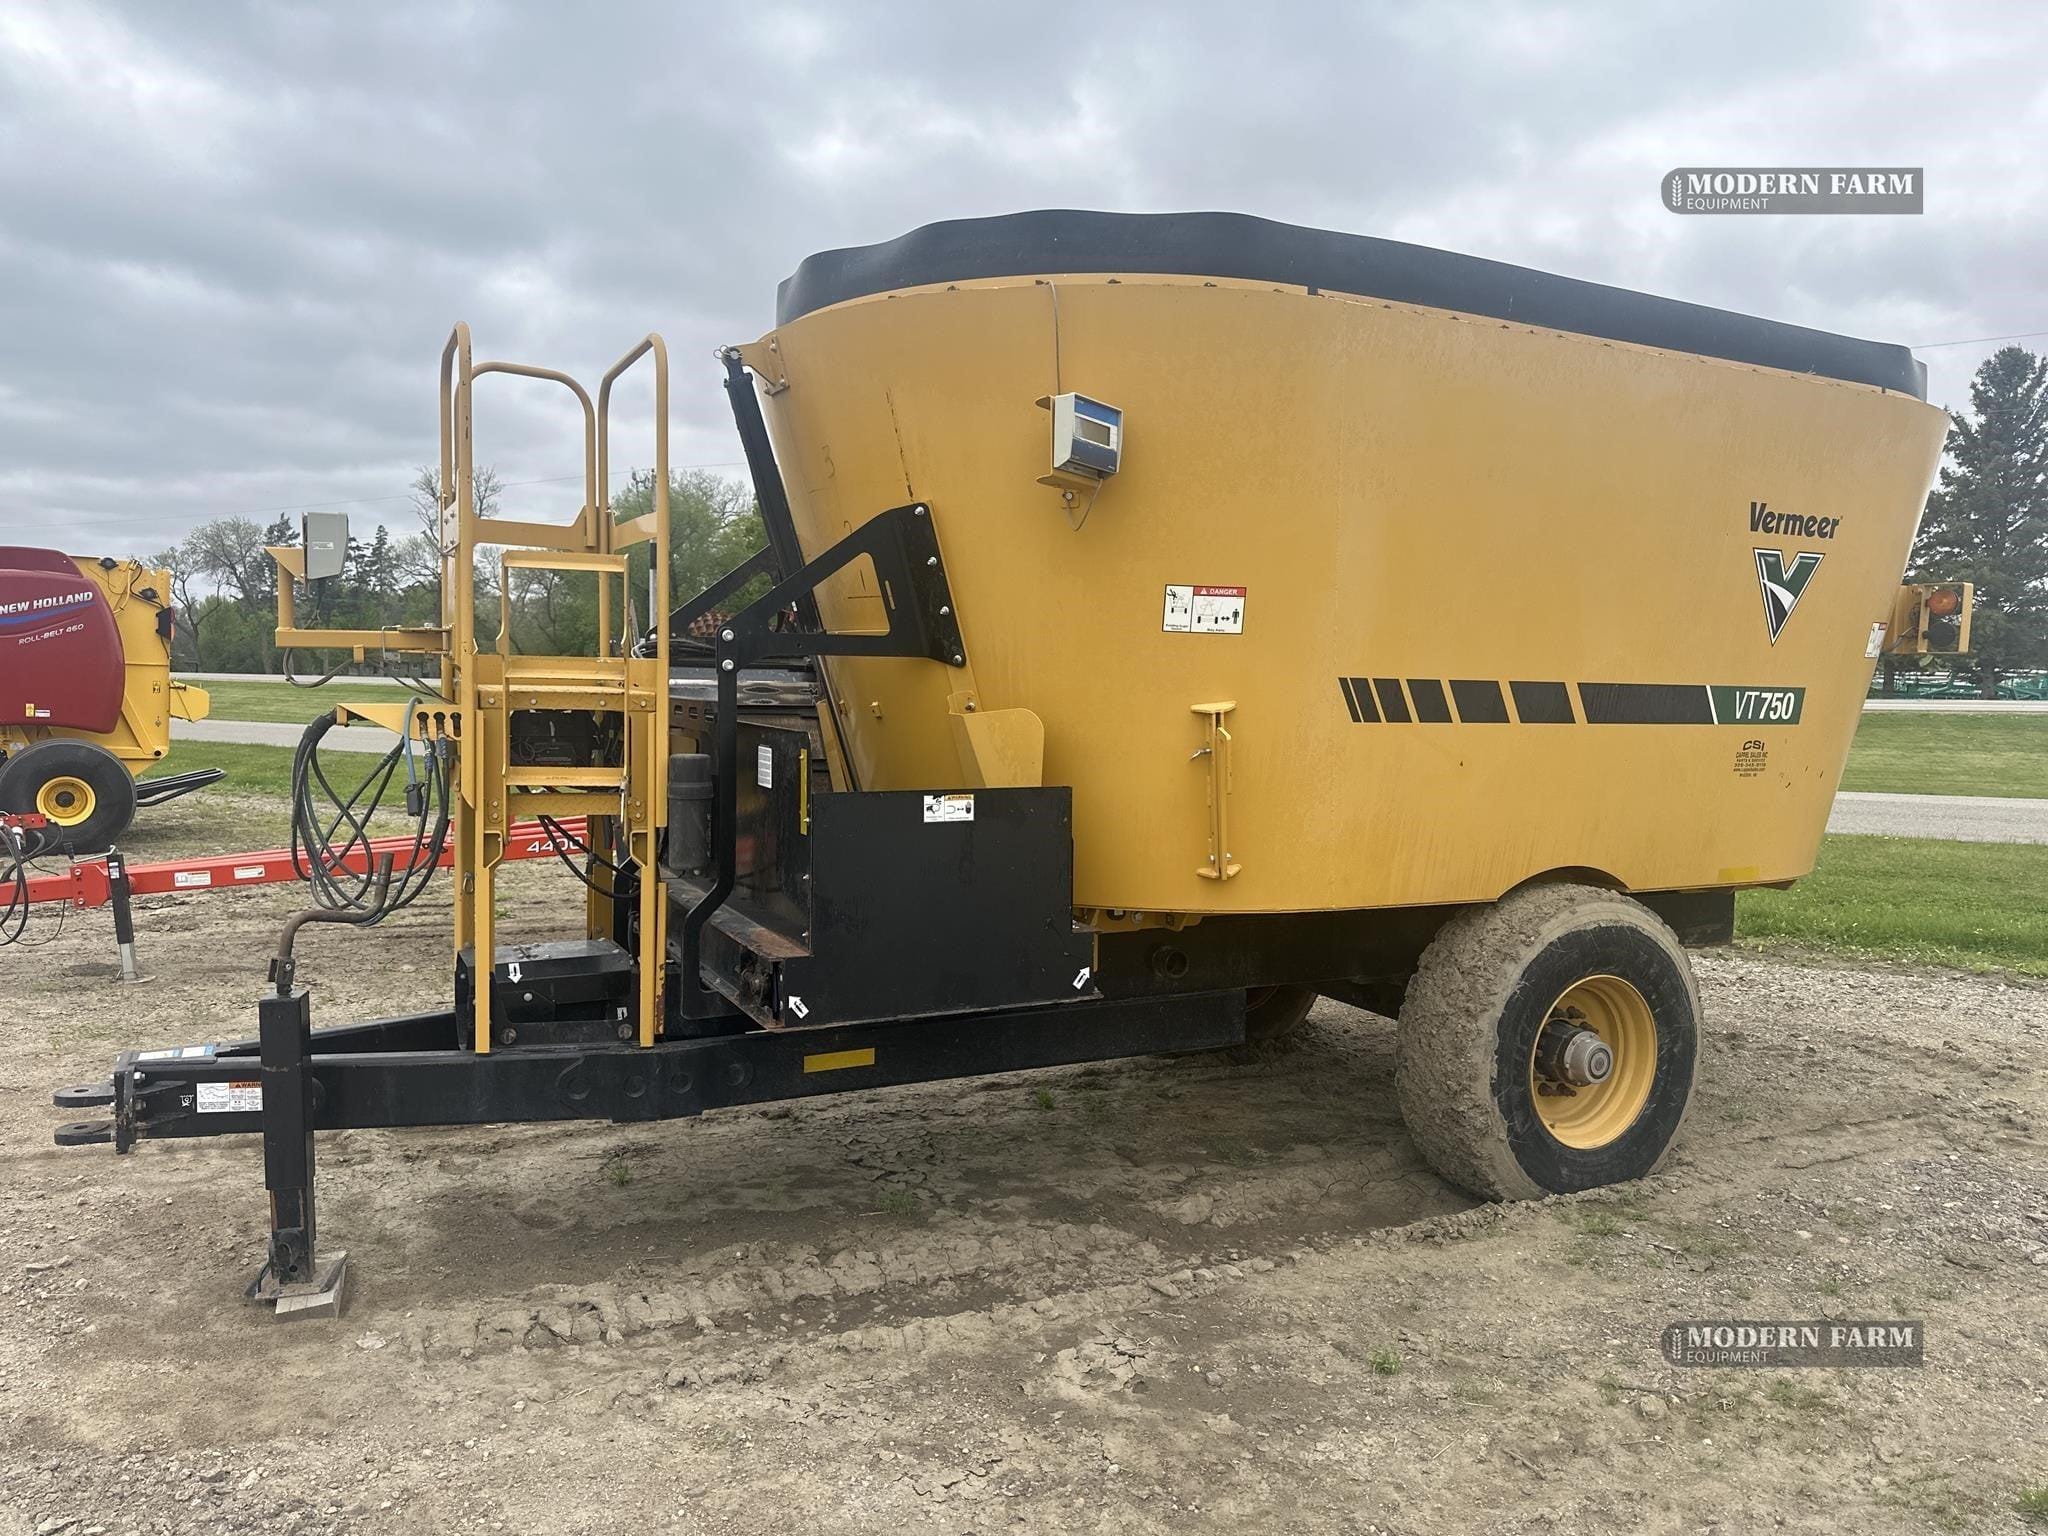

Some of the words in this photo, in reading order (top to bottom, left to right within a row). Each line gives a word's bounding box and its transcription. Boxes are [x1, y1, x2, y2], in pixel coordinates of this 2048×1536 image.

[1750, 501, 1840, 539] Vermeer
[0, 601, 30, 614] NEW
[33, 591, 93, 609] HOLLAND
[18, 628, 64, 645] ROLL-BELT
[66, 623, 85, 633] 460
[1743, 740, 1765, 751] CSI
